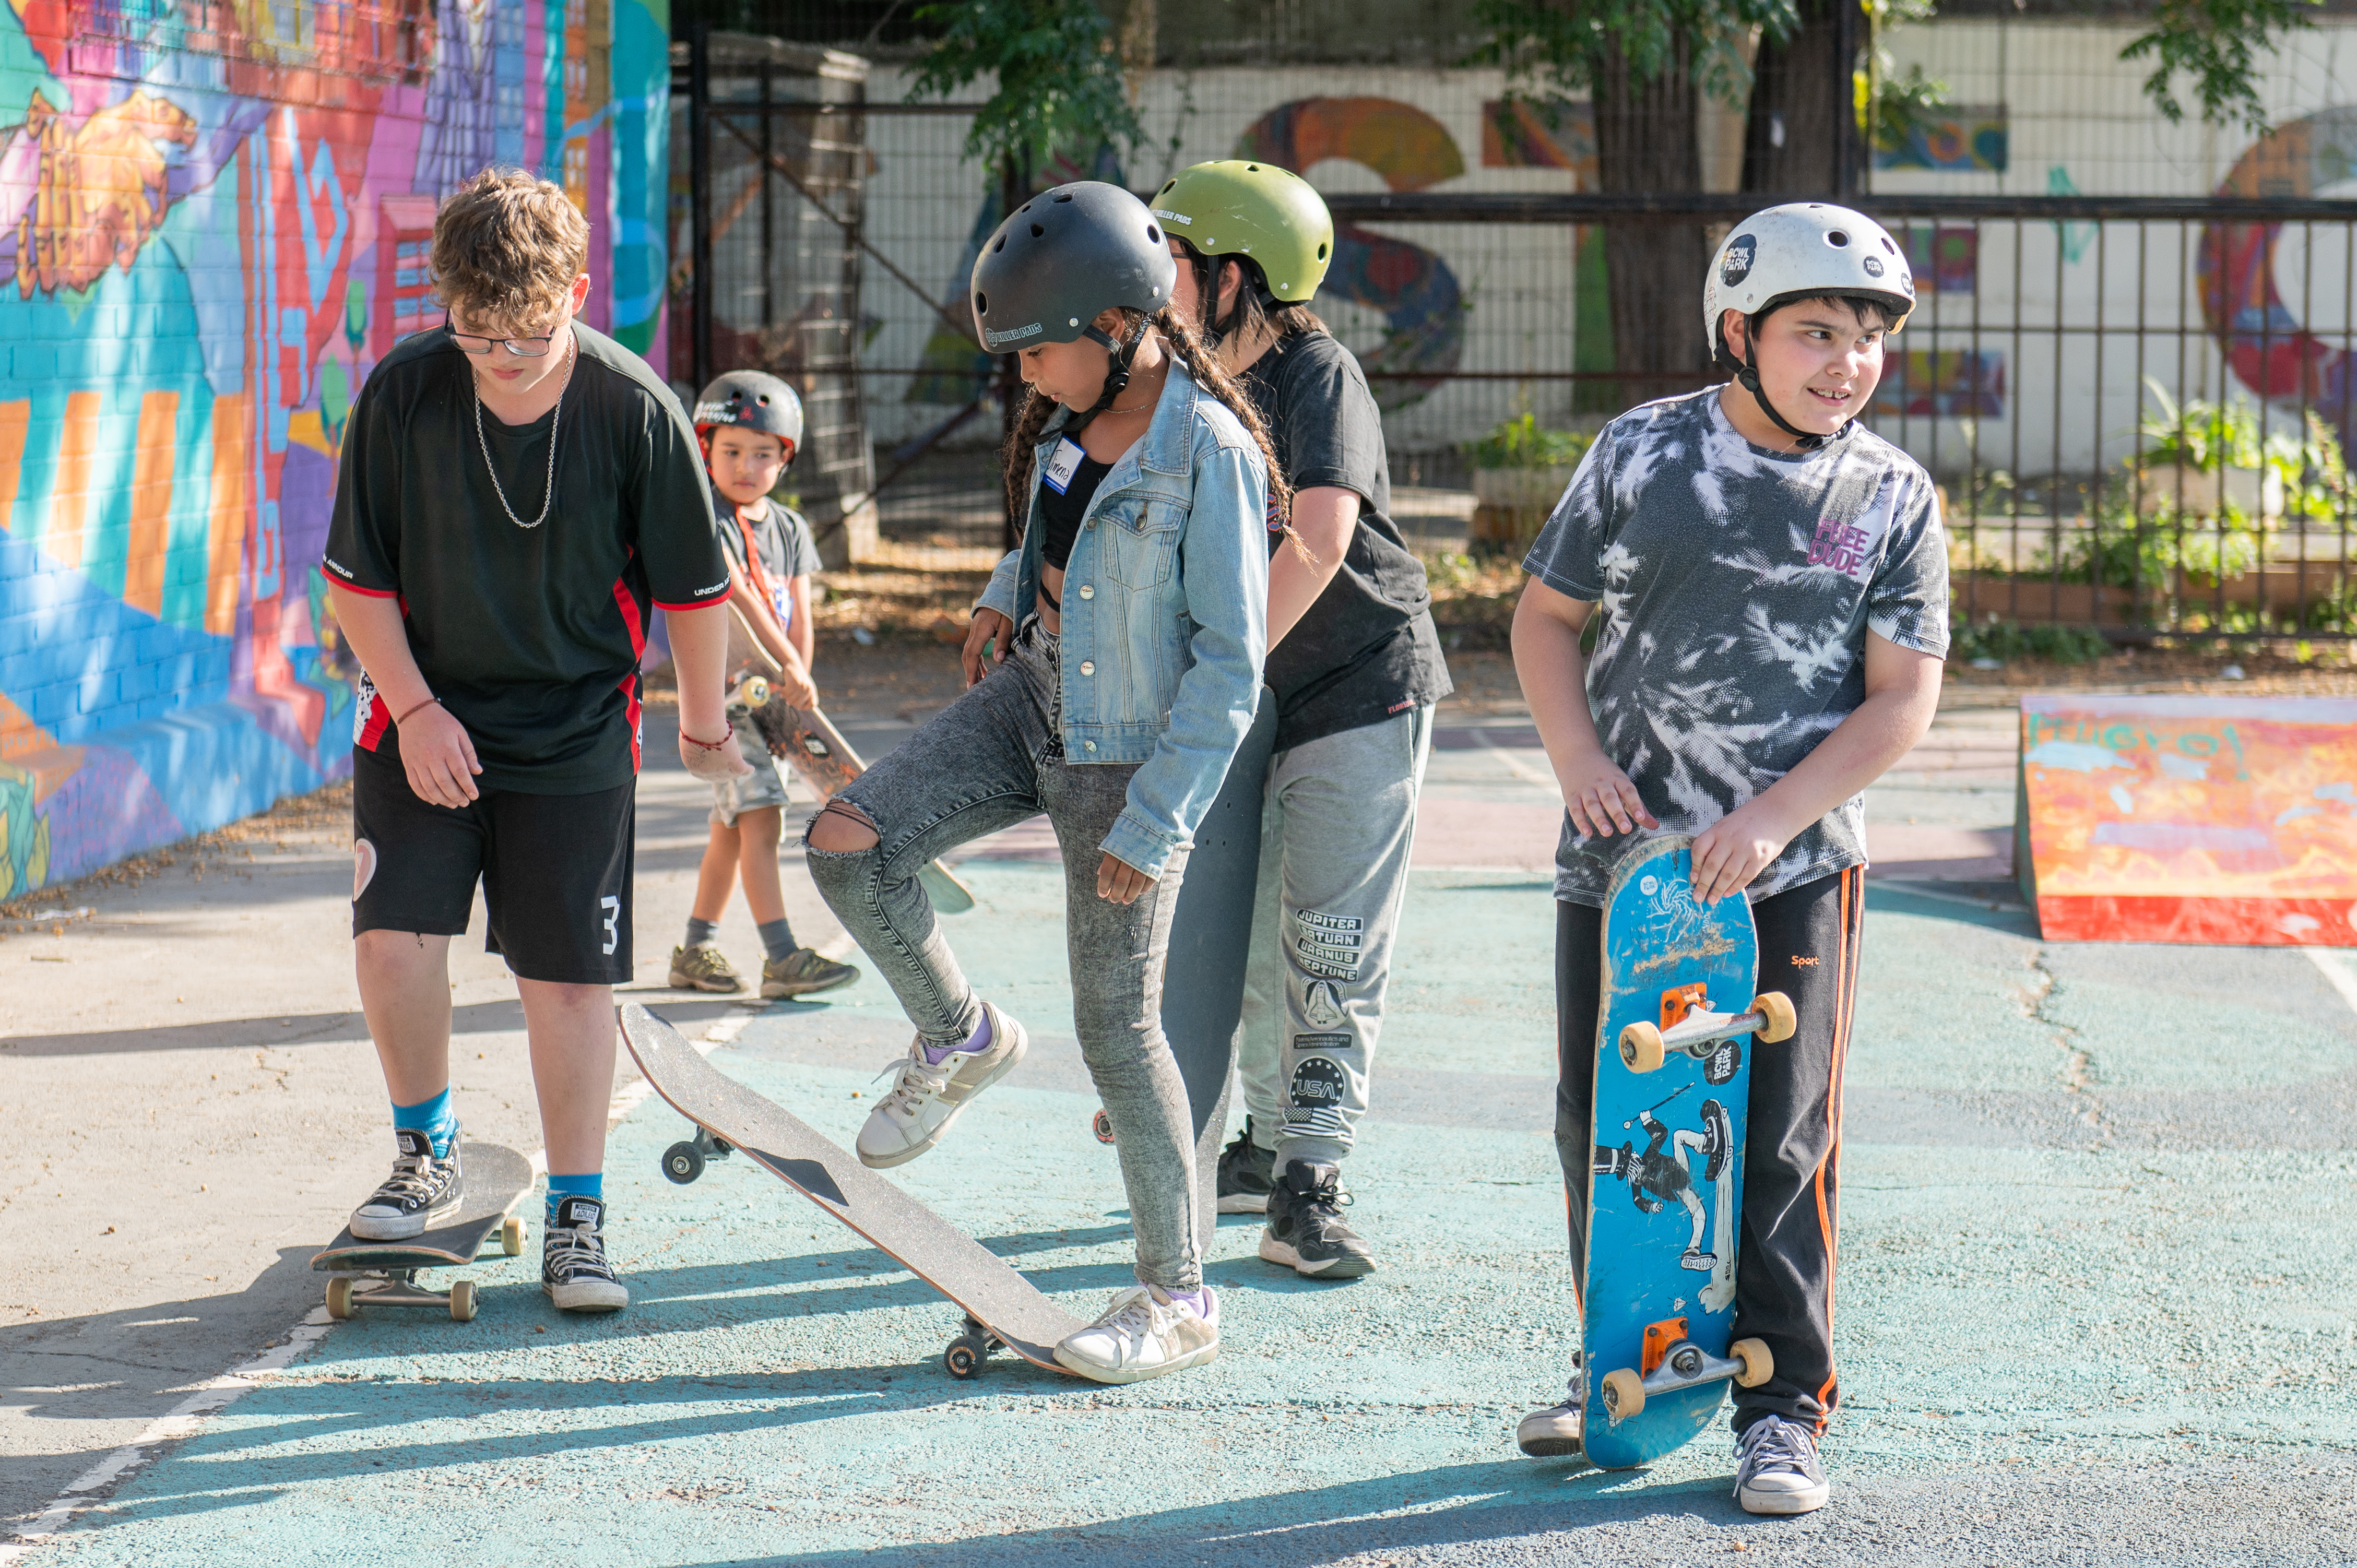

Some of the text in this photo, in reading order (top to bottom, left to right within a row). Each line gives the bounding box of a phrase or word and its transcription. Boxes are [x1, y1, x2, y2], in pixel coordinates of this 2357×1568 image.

[1173, 213, 1192, 225] PADS
[1724, 258, 1749, 271] PARK
[996, 329, 1021, 342] KILLER
[1019, 323, 1043, 338] PADS
[1815, 516, 1870, 552] FREE
[1806, 539, 1865, 576] DUDE
[694, 582, 725, 596] UNDER
[600, 895, 620, 955] 3
[1298, 910, 1357, 930] JUPITER
[1301, 926, 1355, 946] SATURN
[1300, 940, 1354, 963] URANUS
[1298, 956, 1356, 981] NEPTUNE
[1791, 955, 1820, 970] Sport
[1722, 1046, 1732, 1078] PARK
[1297, 1079, 1335, 1100] USA
